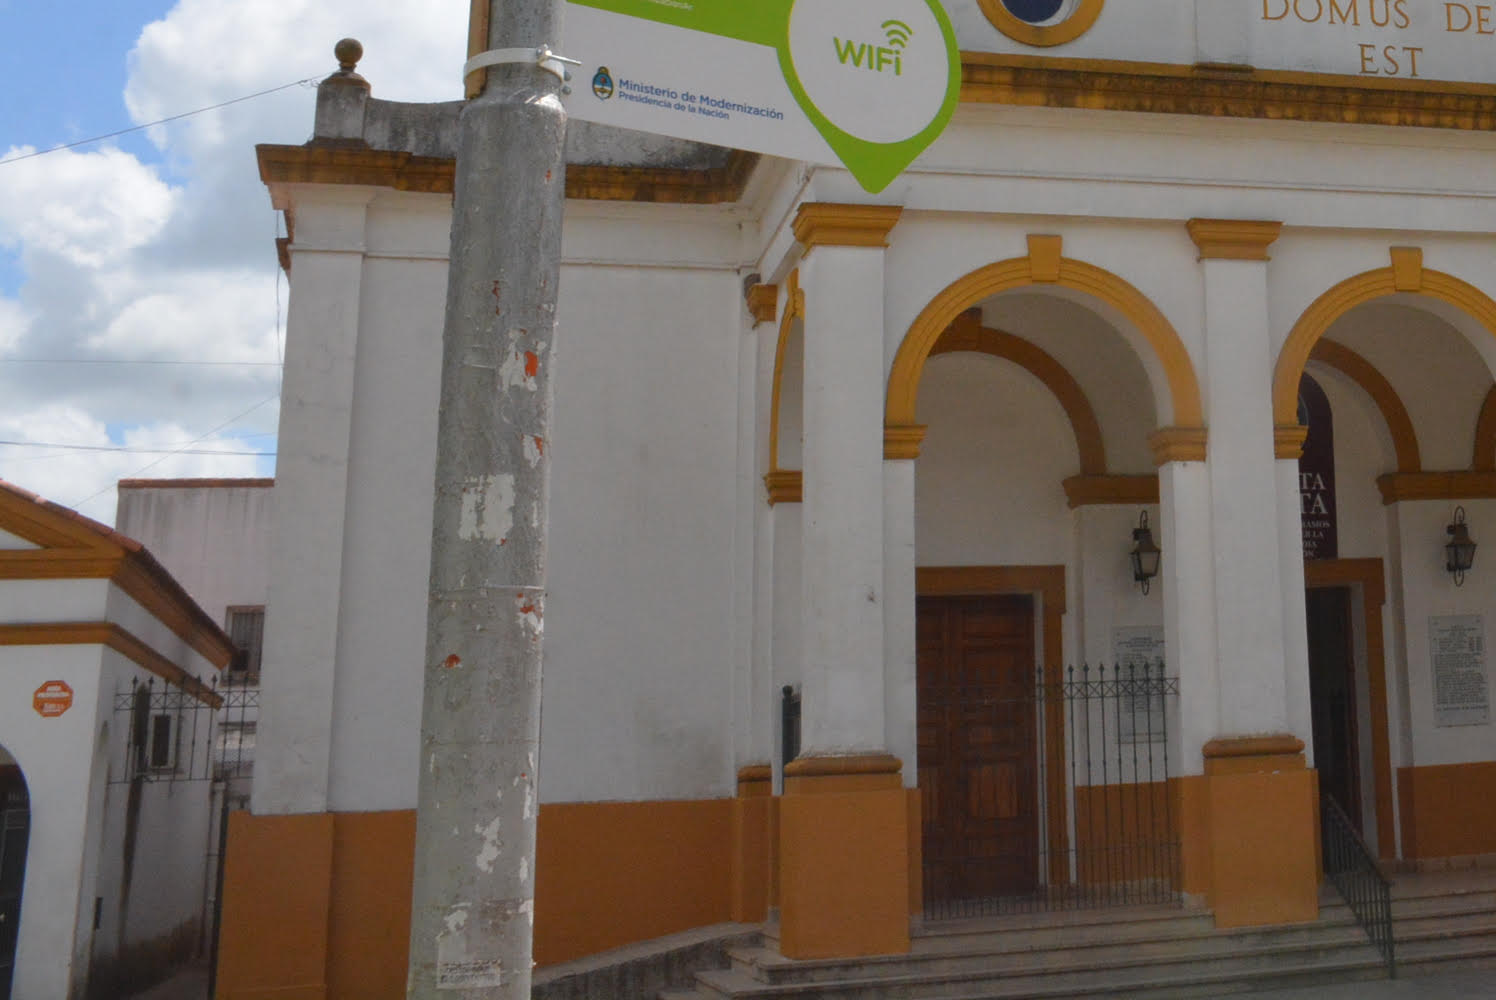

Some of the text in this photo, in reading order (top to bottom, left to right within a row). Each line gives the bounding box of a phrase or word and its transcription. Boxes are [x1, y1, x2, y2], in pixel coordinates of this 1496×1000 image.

[1358, 44, 1423, 77] EST
[618, 78, 784, 121] Ministerio de Modernización
[618, 91, 730, 120] Presidencia de la Nación
